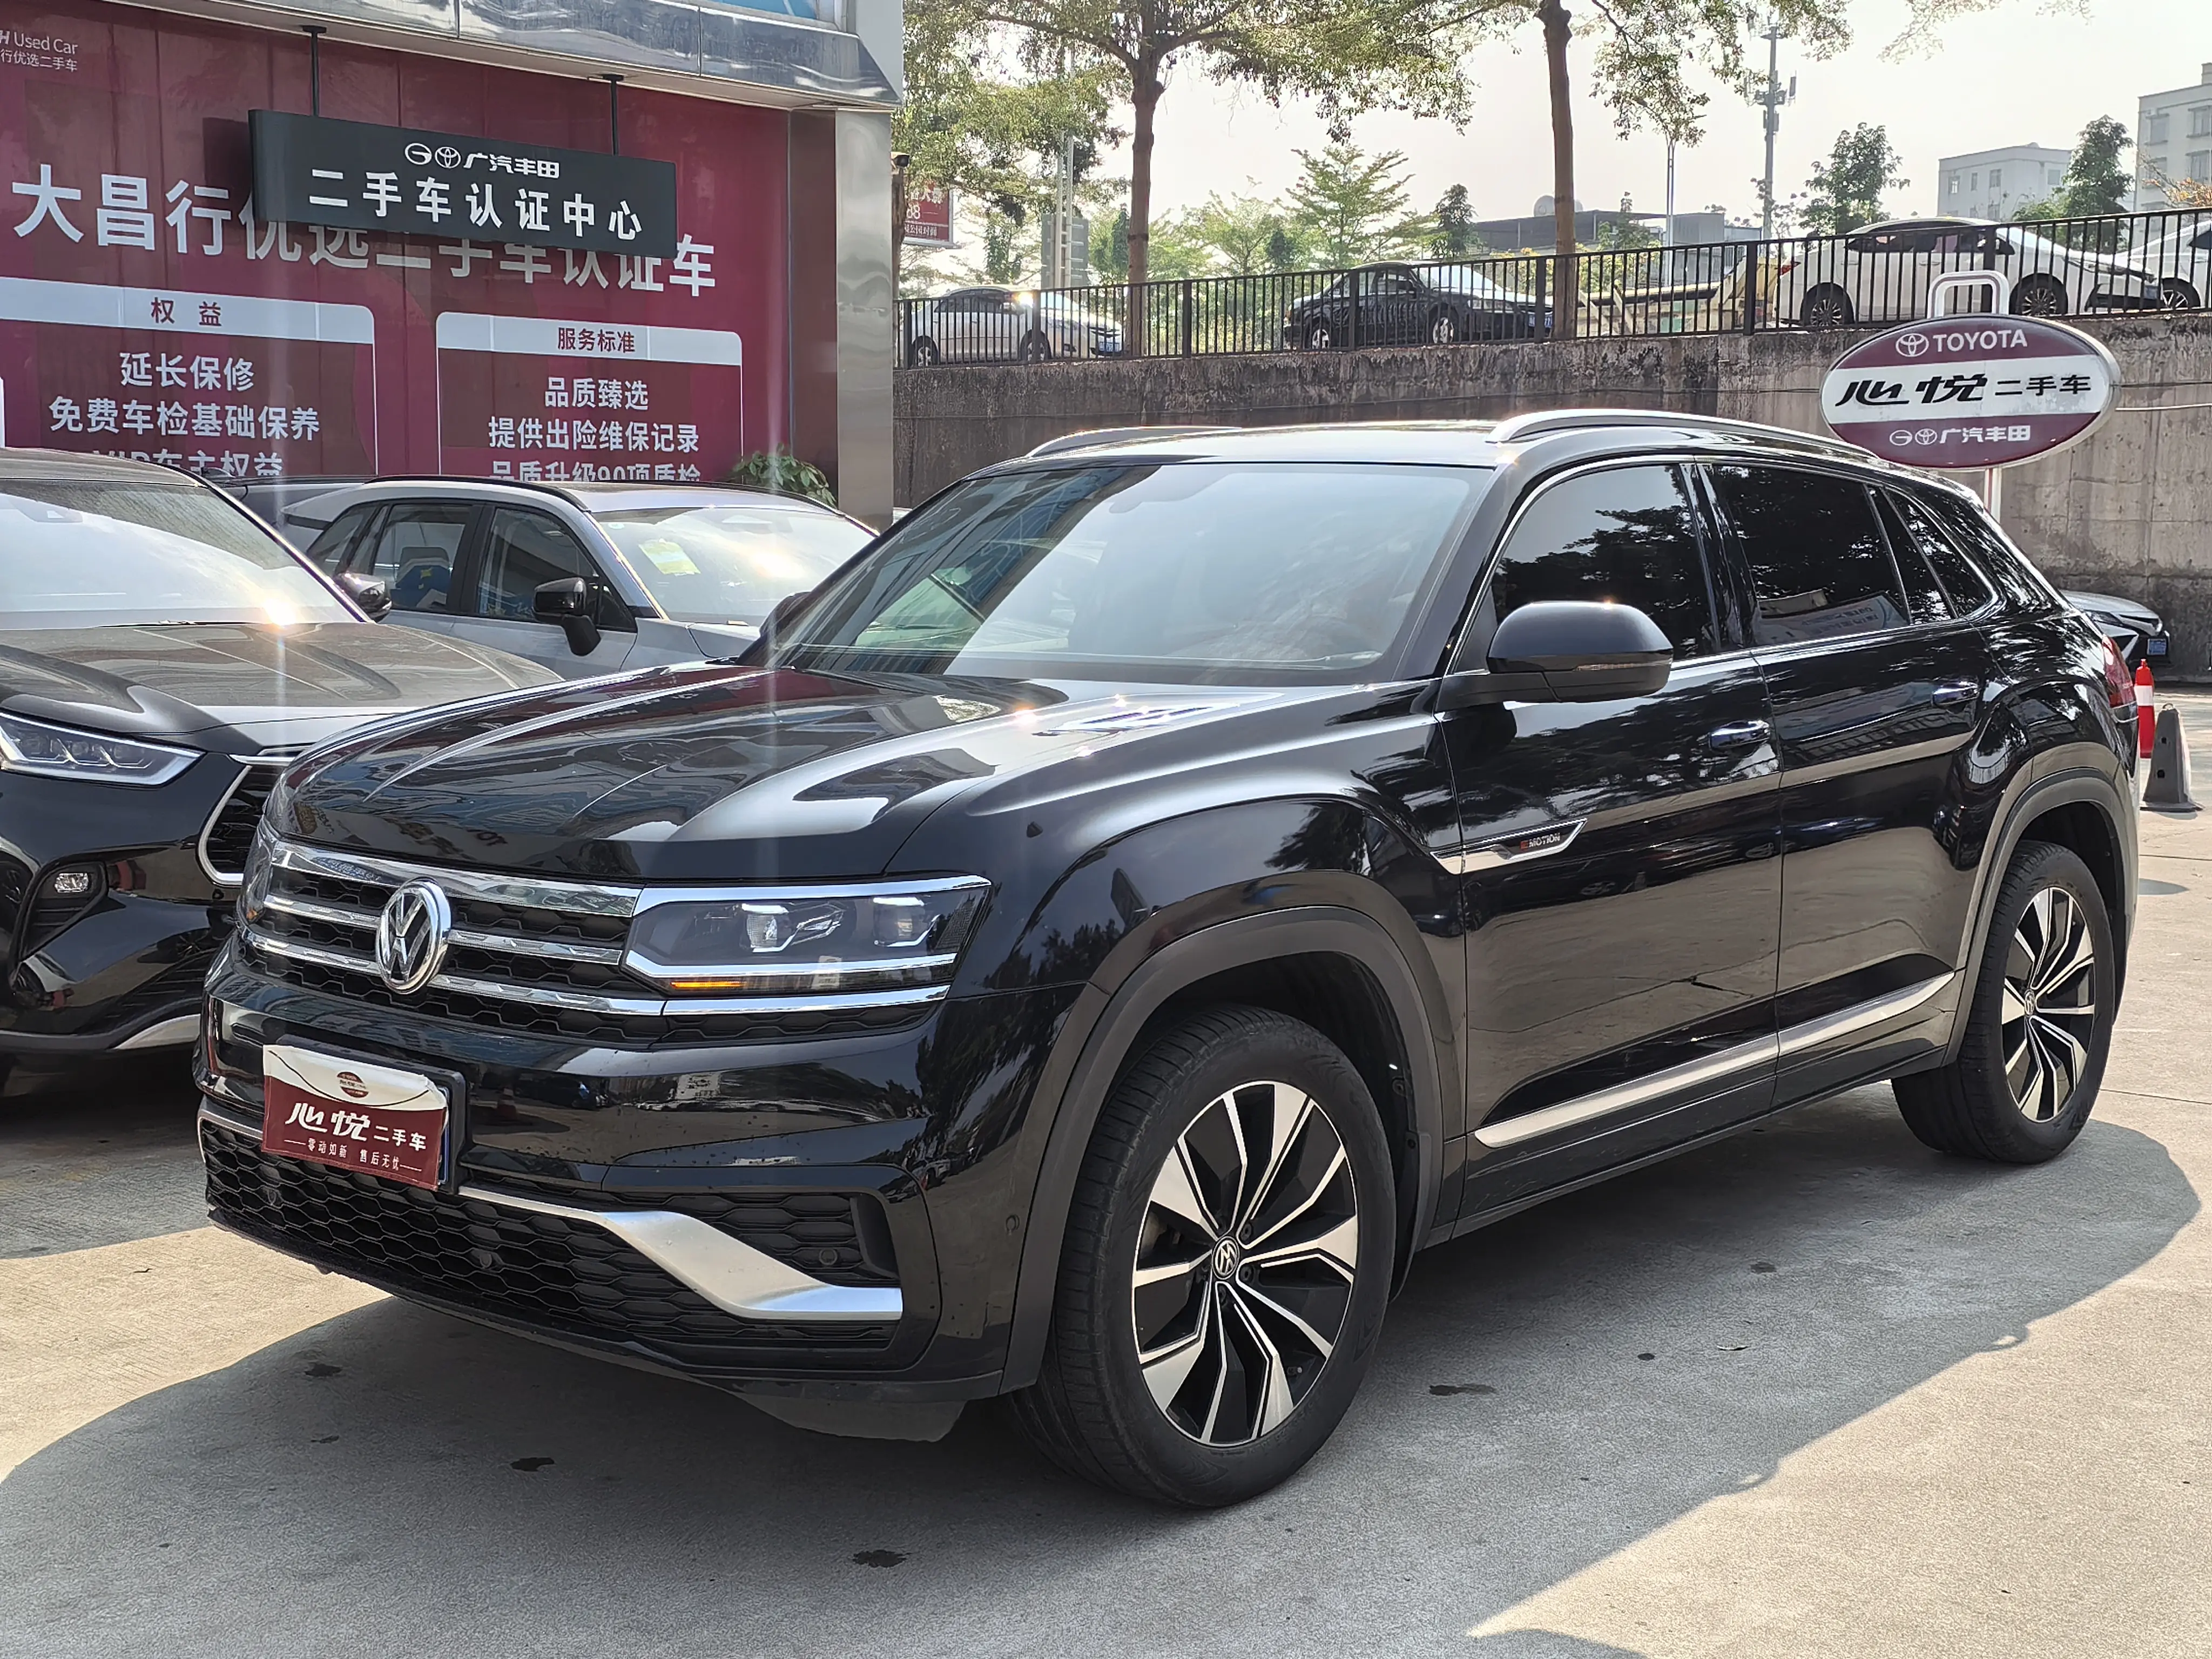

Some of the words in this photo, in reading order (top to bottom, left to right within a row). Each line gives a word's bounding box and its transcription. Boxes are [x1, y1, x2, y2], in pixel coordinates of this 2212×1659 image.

[14, 31, 50, 51] Used
[53, 38, 78, 55] Car
[1, 48, 78, 72] 行优选二手车
[463, 152, 560, 179] 广汽丰田
[309, 168, 643, 241] 二手车认证中心
[151, 296, 222, 327] 权益
[557, 327, 636, 354] 服务标准
[1933, 328, 2028, 352] TOYOTA
[119, 351, 254, 392] 延长保修
[544, 376, 649, 410] 品质臻选
[48, 395, 320, 441] 免费车检基础保养
[488, 415, 699, 453] 提供出险维保记录
[1939, 424, 2031, 444] 广汽丰田
[92, 448, 284, 477] 车主权益
